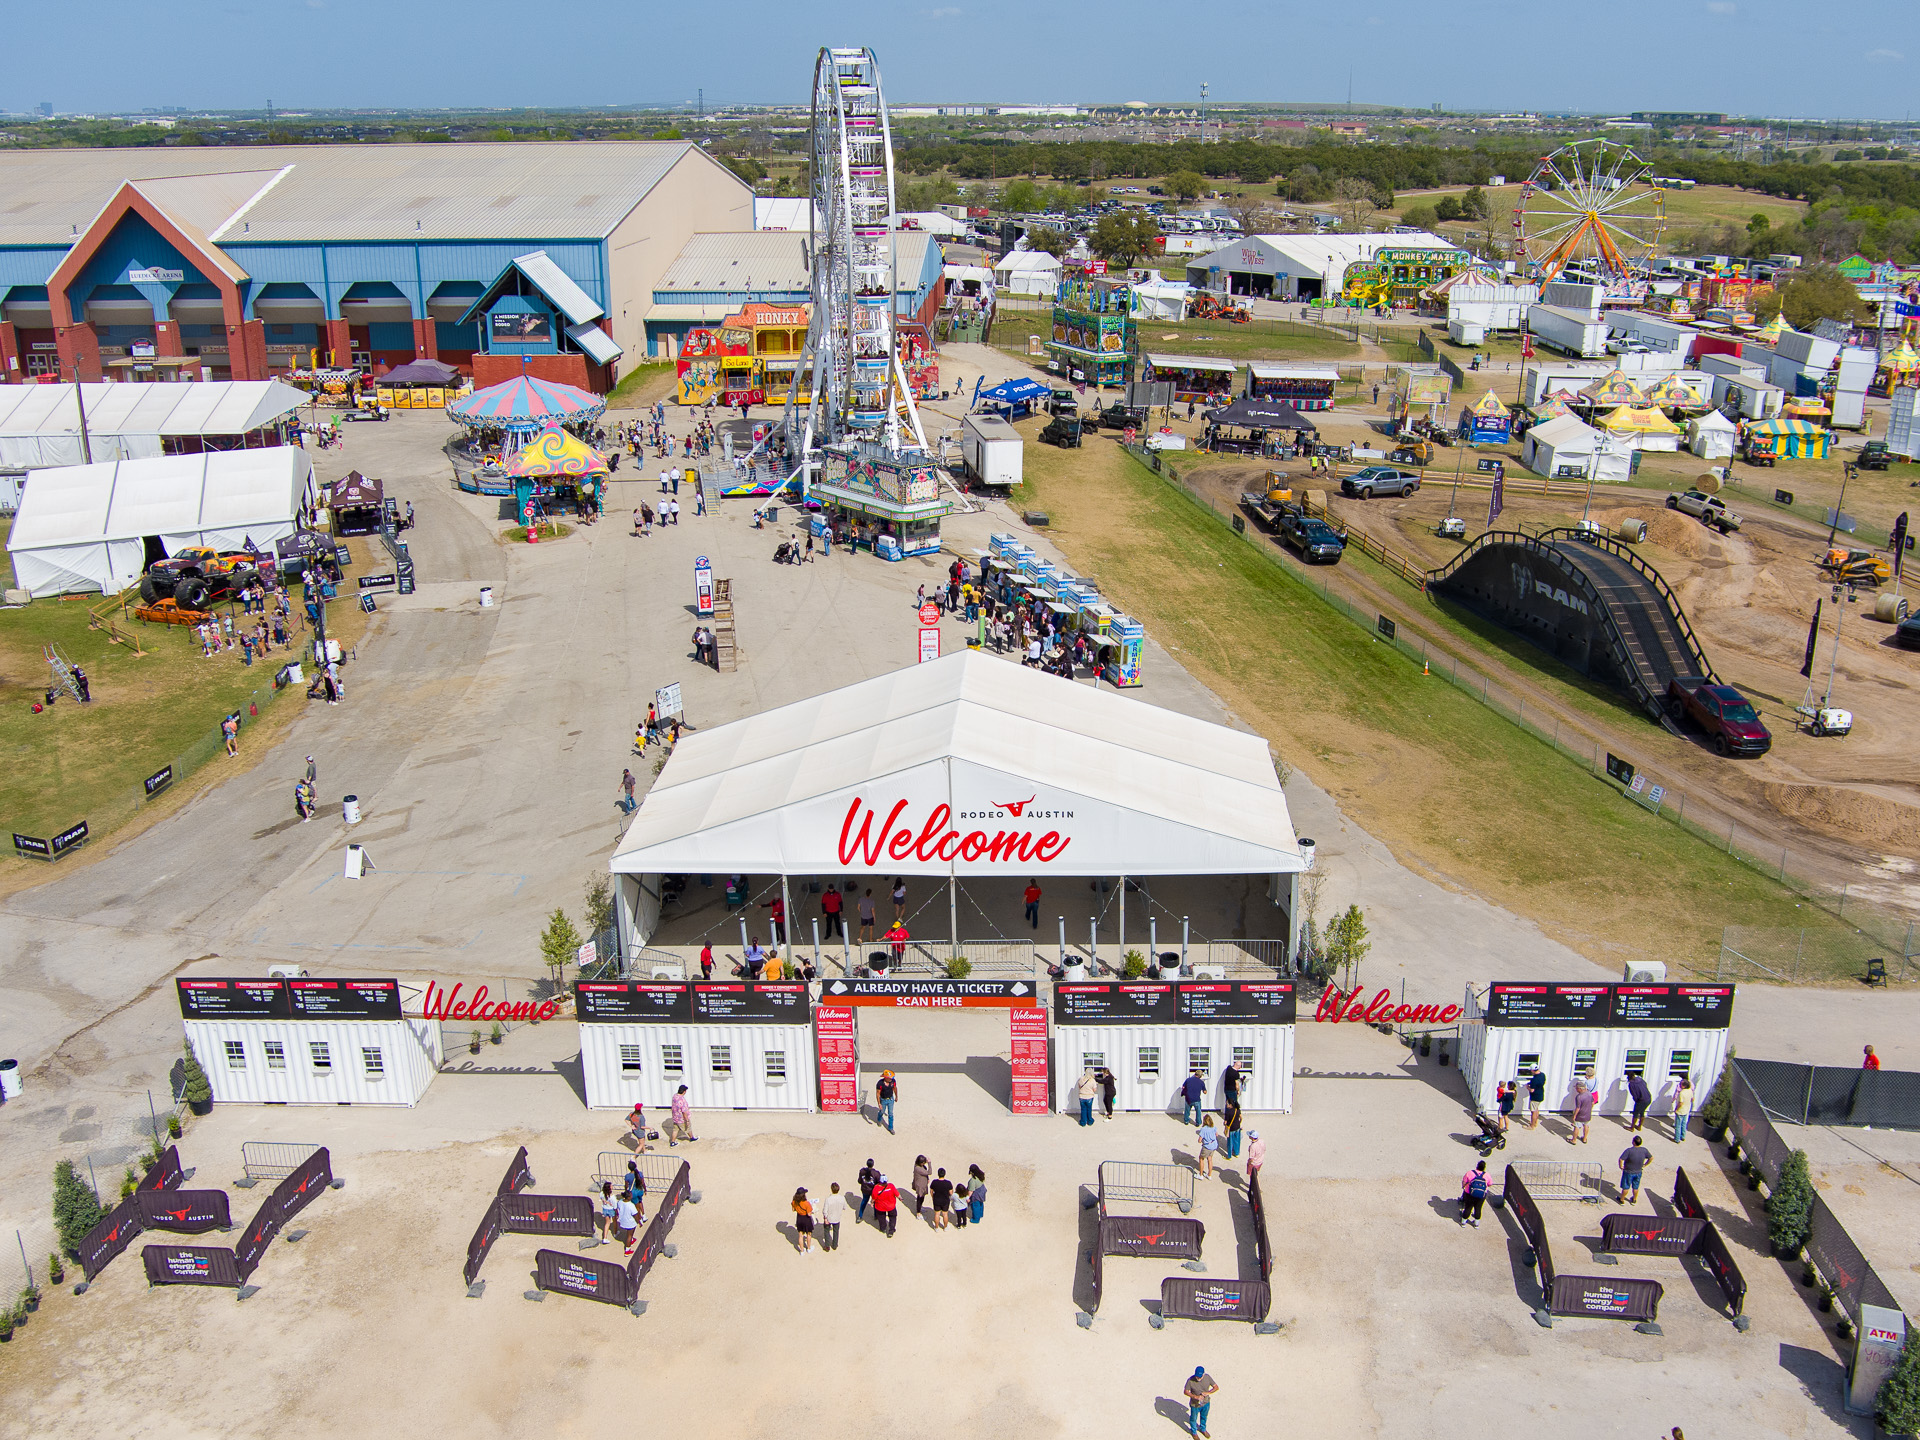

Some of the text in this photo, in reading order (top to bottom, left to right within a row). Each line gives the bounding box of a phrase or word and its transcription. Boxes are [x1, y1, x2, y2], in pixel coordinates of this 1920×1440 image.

[1242, 248, 1256, 258] WILD
[1392, 252, 1455, 260] MONKEY MAZE
[1248, 255, 1265, 266] WEST
[756, 312, 799, 324] HONKY
[1012, 382, 1038, 393] POLARIS
[1535, 580, 1588, 616] RAM
[154, 770, 170, 784] RAM
[64, 826, 85, 843] RAM
[838, 796, 1072, 867] Welcome
[24, 840, 45, 849] RAM
[854, 984, 1004, 994] ALREADY HAVE A TICKET?
[423, 980, 560, 1022] Welcome
[896, 997, 962, 1006] SCAN HERE
[1316, 984, 1464, 1024] Welcome
[819, 1009, 850, 1019] Welcome
[1012, 1010, 1044, 1020] Welcome
[284, 1172, 324, 1209] RODEO AUSTIN
[558, 1267, 583, 1277] human
[559, 1274, 584, 1284] energy
[564, 1280, 597, 1292] company
[1195, 1290, 1223, 1299] human
[1584, 1291, 1613, 1300] human
[1195, 1296, 1223, 1305] energy
[1583, 1298, 1612, 1306] energy
[1586, 1304, 1624, 1313] company
[1869, 1329, 1897, 1340] ATM
